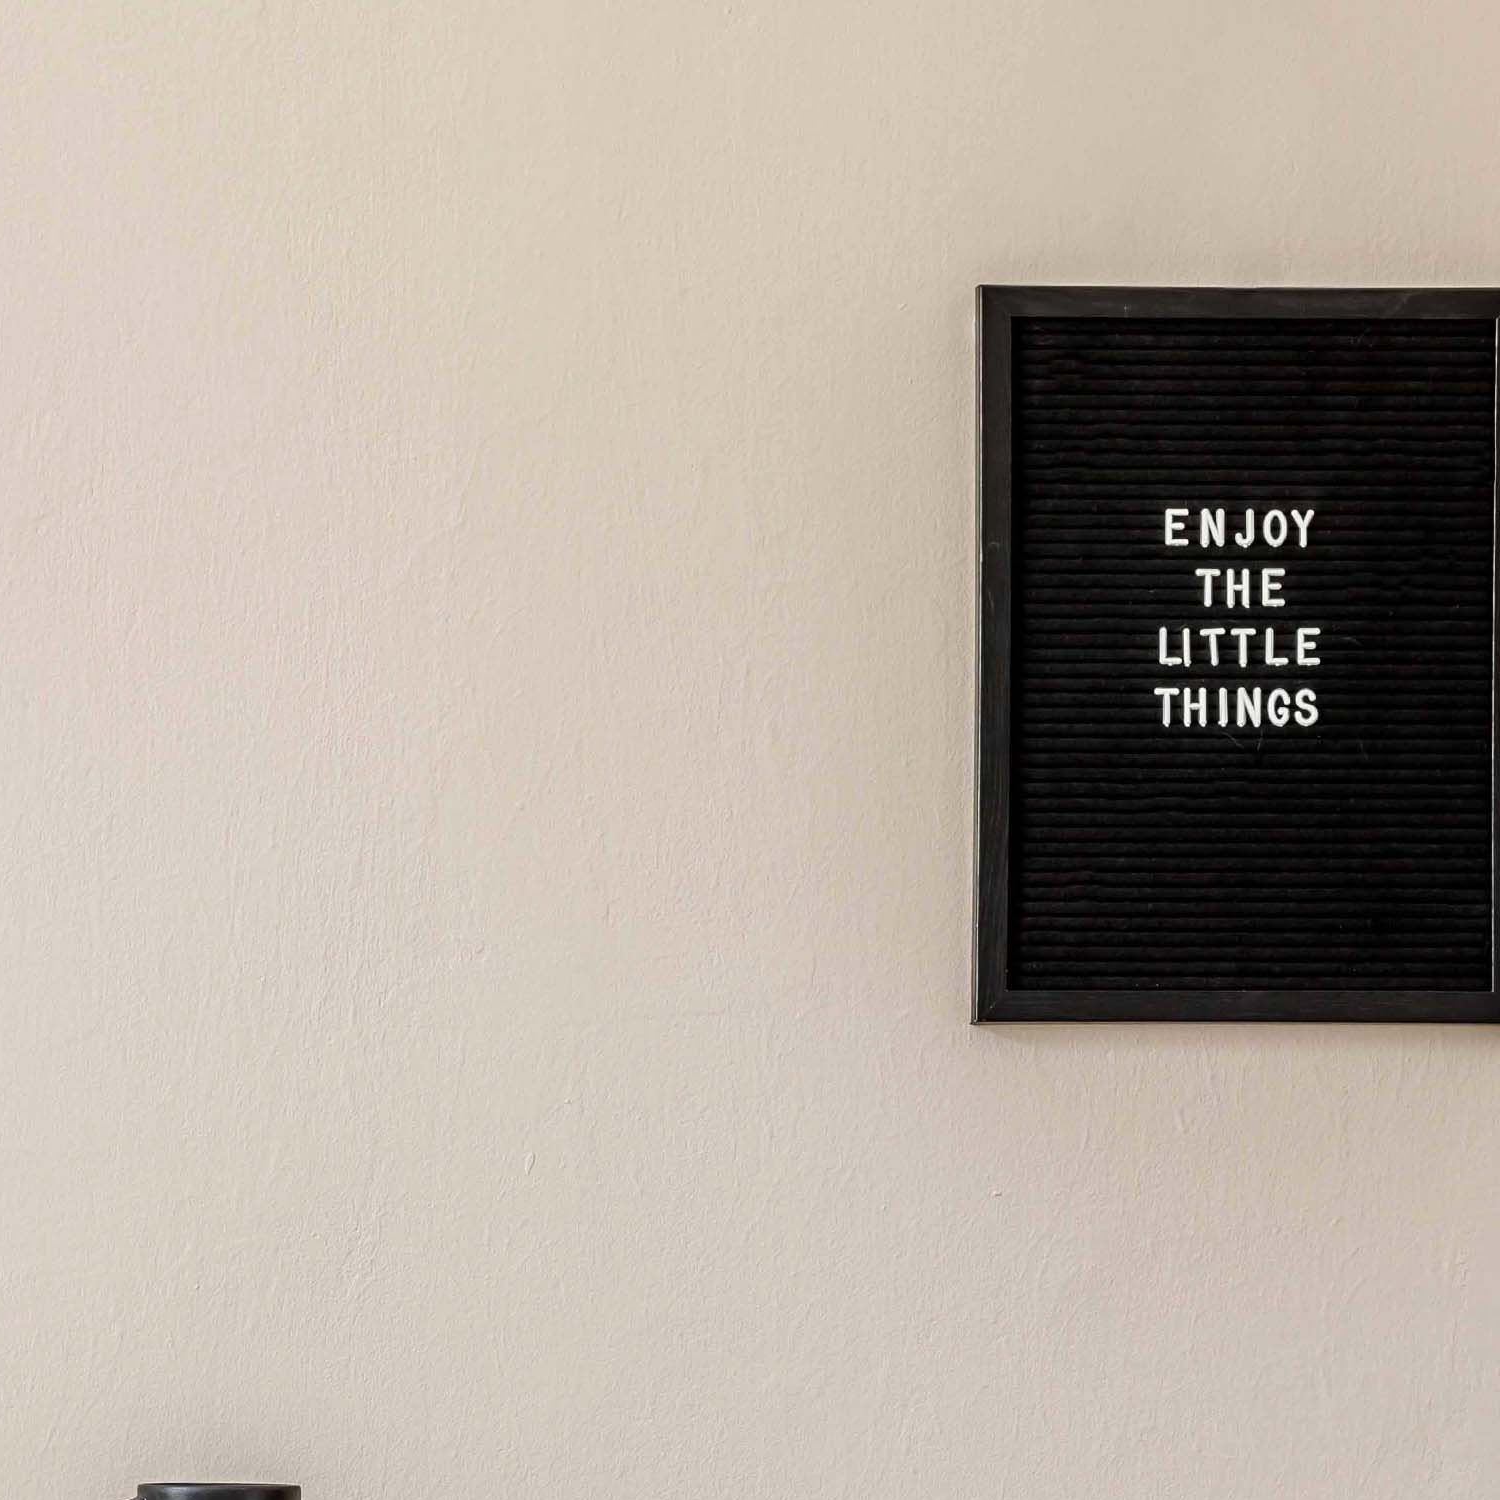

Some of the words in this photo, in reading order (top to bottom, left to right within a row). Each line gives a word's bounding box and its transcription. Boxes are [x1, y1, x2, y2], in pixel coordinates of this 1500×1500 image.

[1164, 507, 1315, 549] ENJOY
[1194, 567, 1286, 609] THE
[1158, 626, 1321, 668] LITTLE
[1153, 686, 1319, 728] THINGS
